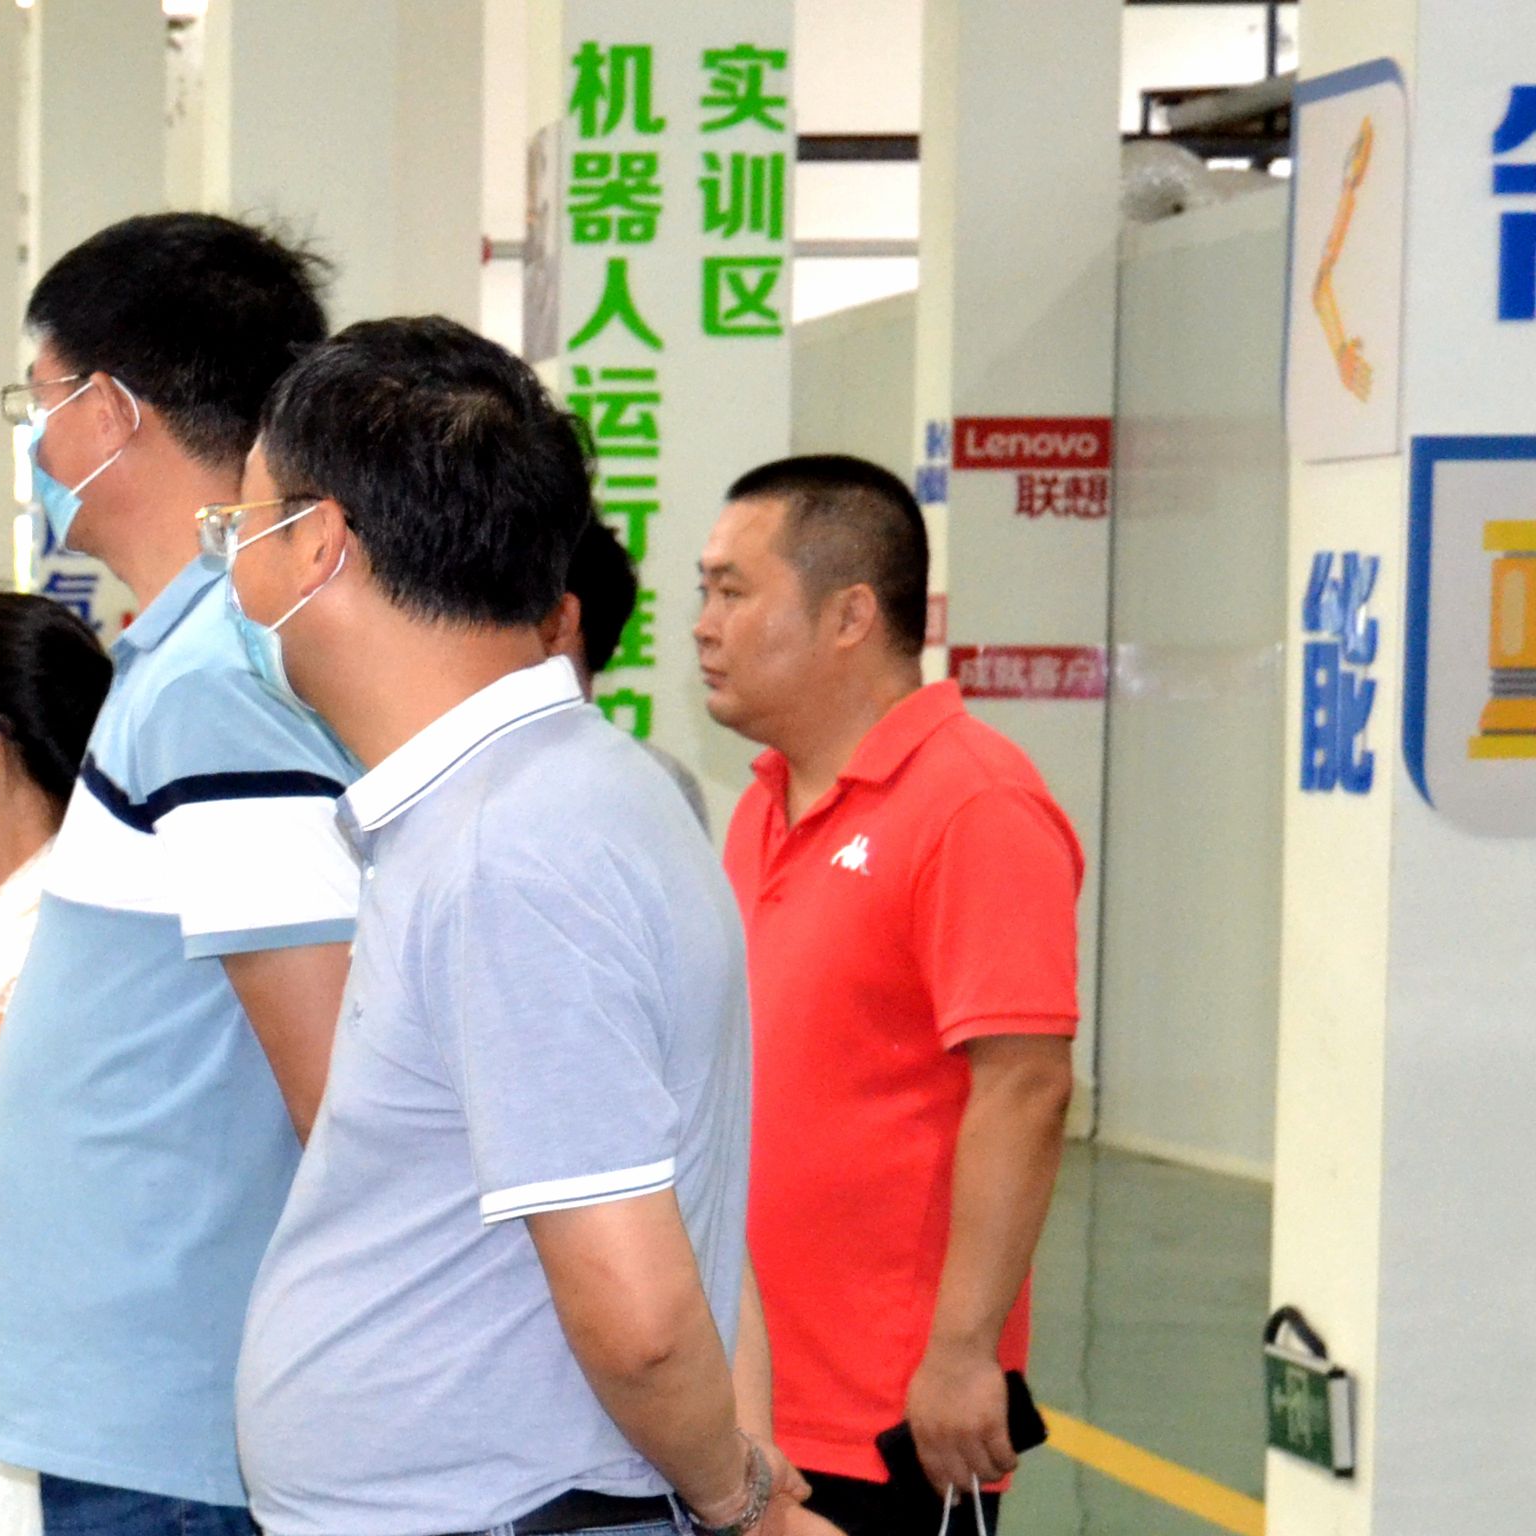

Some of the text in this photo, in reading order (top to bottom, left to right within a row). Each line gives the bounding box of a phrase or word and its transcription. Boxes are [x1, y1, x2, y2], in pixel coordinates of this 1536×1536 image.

[697, 43, 789, 338] 实训区
[965, 428, 1100, 458] Lenovo
[1015, 474, 1108, 519] 联想
